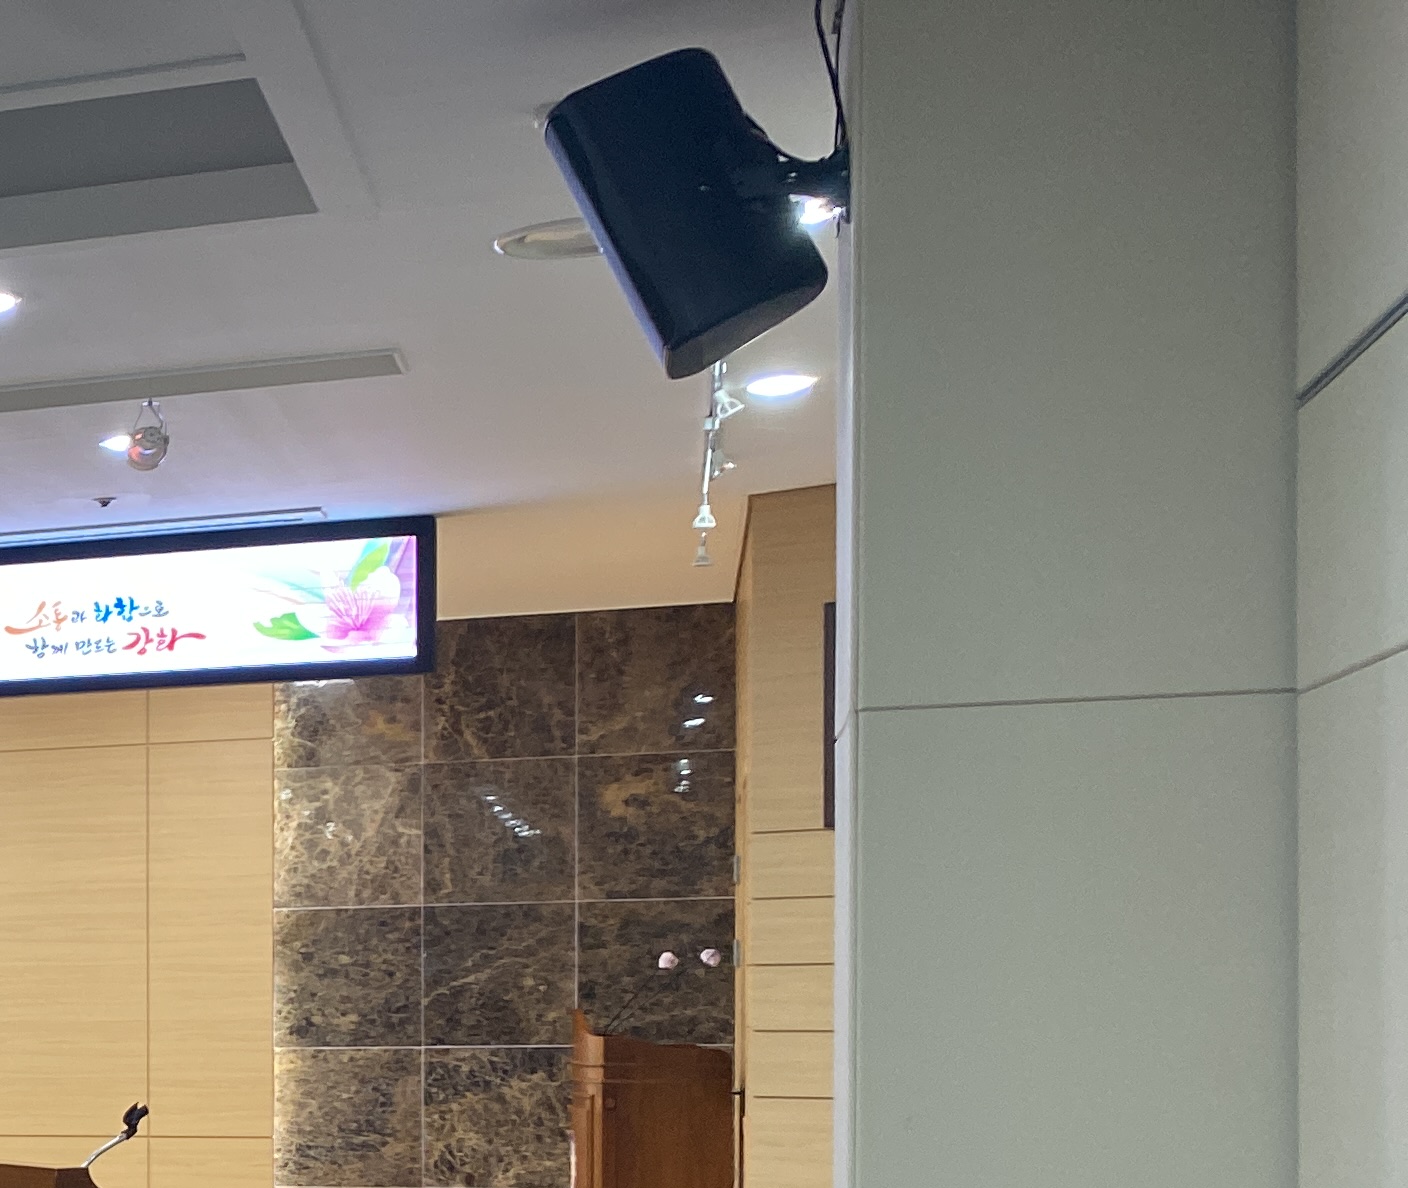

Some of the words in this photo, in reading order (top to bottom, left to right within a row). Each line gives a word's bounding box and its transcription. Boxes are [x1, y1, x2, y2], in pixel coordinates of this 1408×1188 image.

[4, 600, 87, 635] 소통과
[93, 596, 170, 624] 화합으로
[25, 636, 68, 659] 함께
[75, 637, 117, 656] 만드는
[122, 626, 206, 656] 강화
